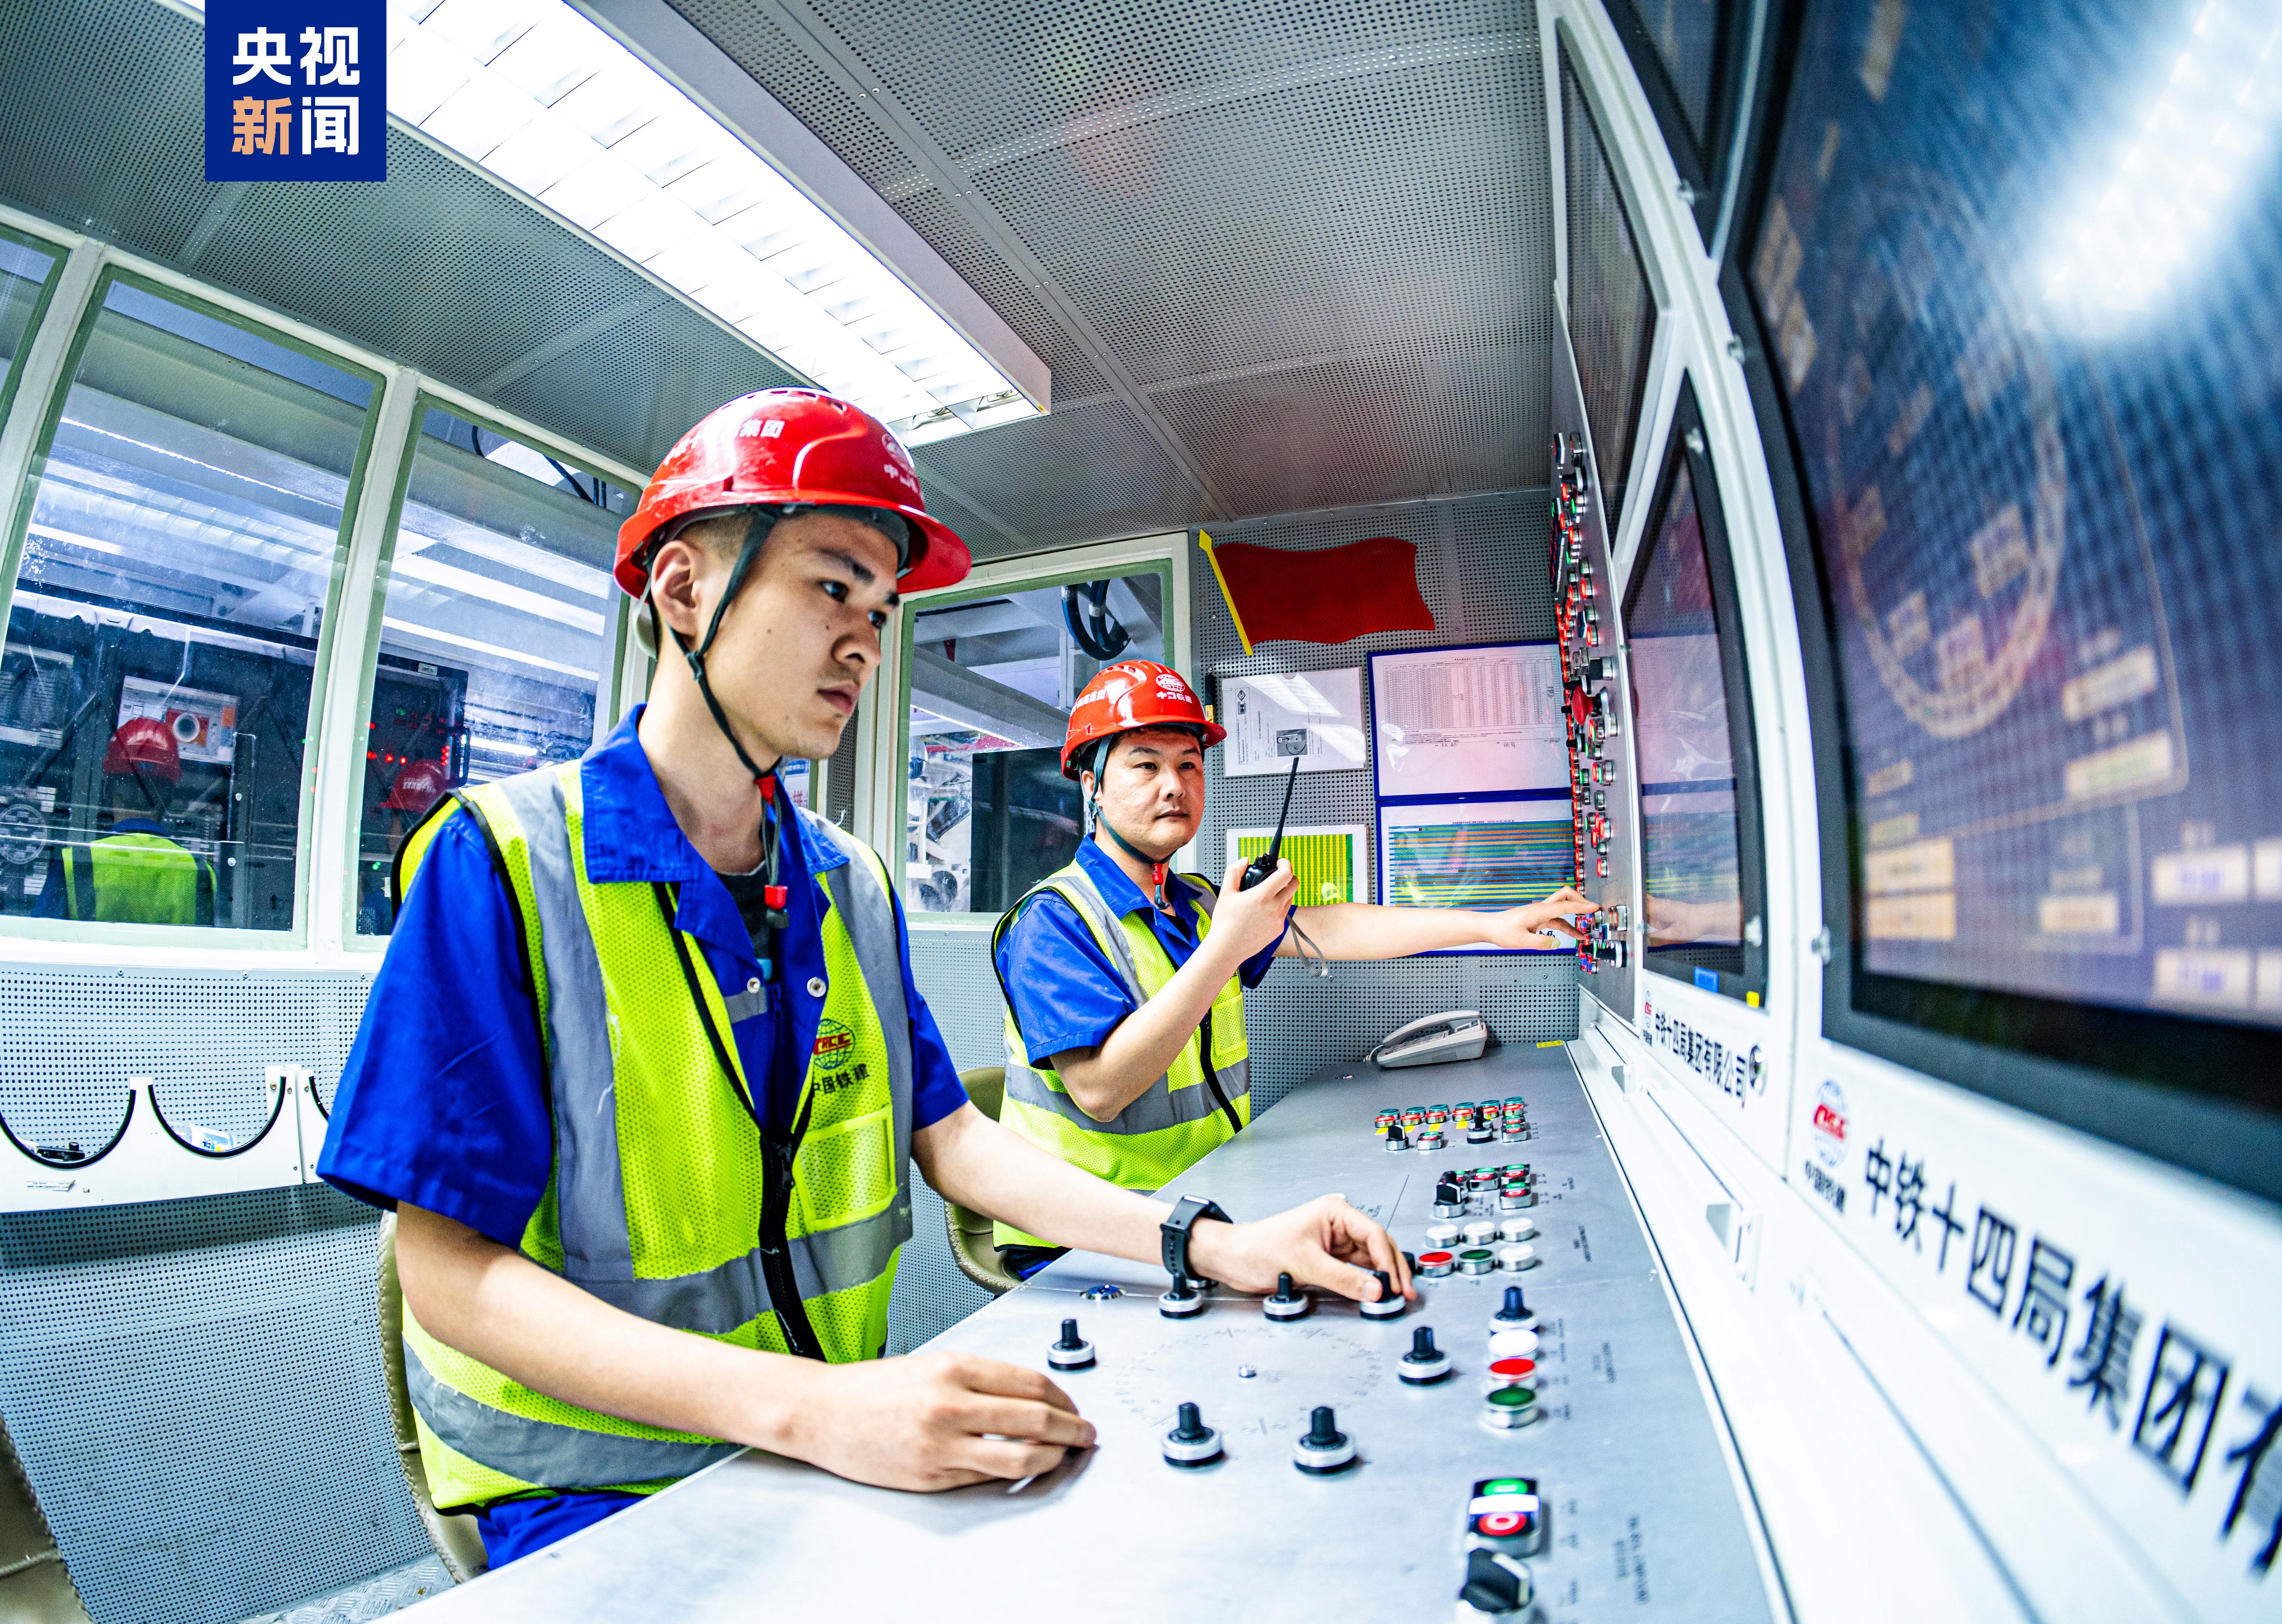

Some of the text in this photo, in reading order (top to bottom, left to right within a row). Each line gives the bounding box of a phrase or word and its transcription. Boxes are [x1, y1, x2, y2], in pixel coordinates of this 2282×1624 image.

[1656, 1008, 1746, 1105] 中铁十四局集团有限公司
